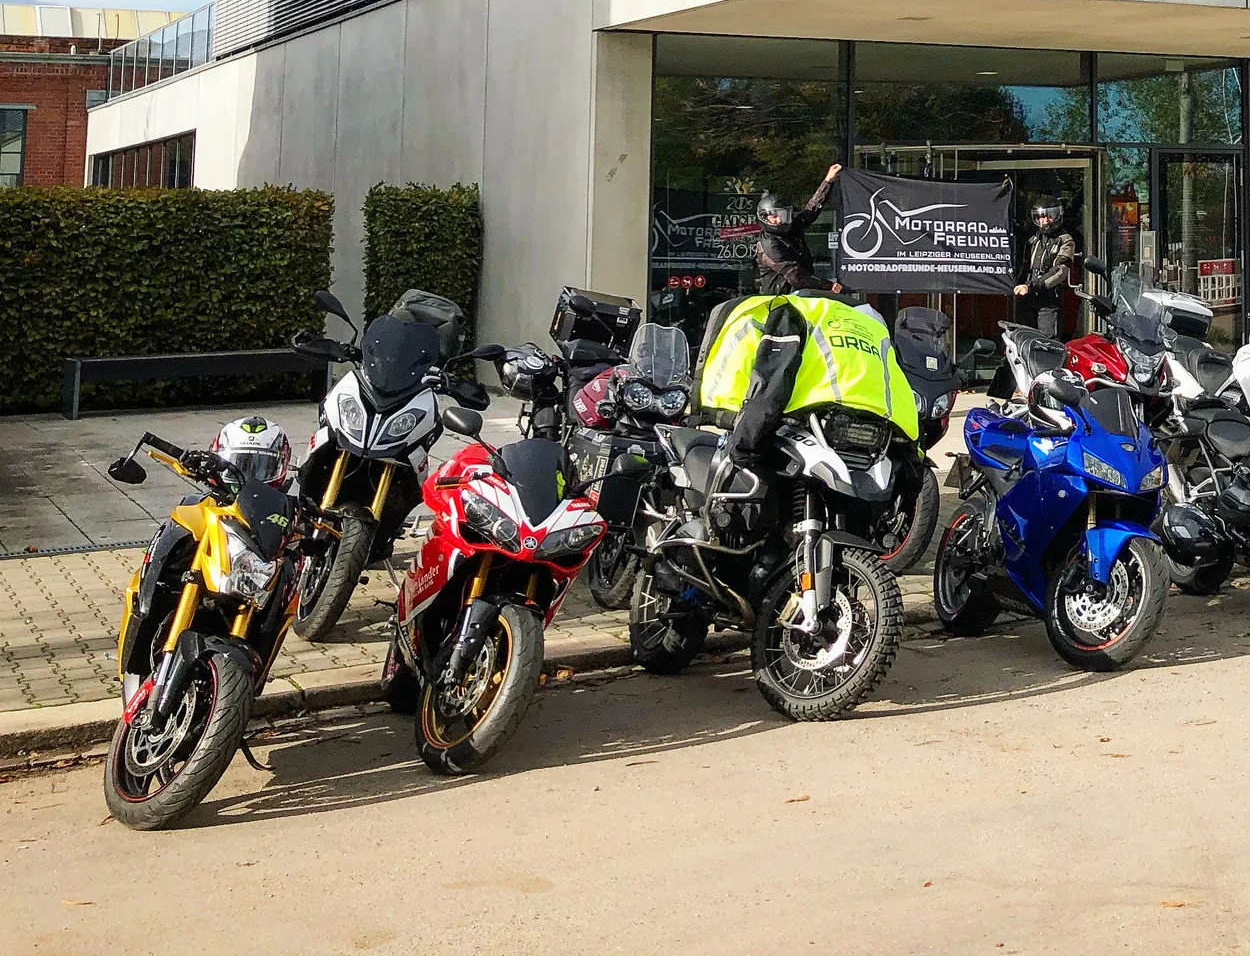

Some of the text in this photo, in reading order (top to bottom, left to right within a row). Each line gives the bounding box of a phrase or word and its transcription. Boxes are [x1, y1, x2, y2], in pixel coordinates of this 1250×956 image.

[895, 216, 989, 234] MOTORRAD
[933, 232, 1010, 248] FREUNDE
[896, 250, 1011, 261] IM LEIPZIGER NEUSEENLAND
[847, 263, 1007, 275] MOTORRADFREUNDE-NEUSEENLAND.DE
[828, 335, 882, 360] ORGA
[266, 513, 290, 528] 46
